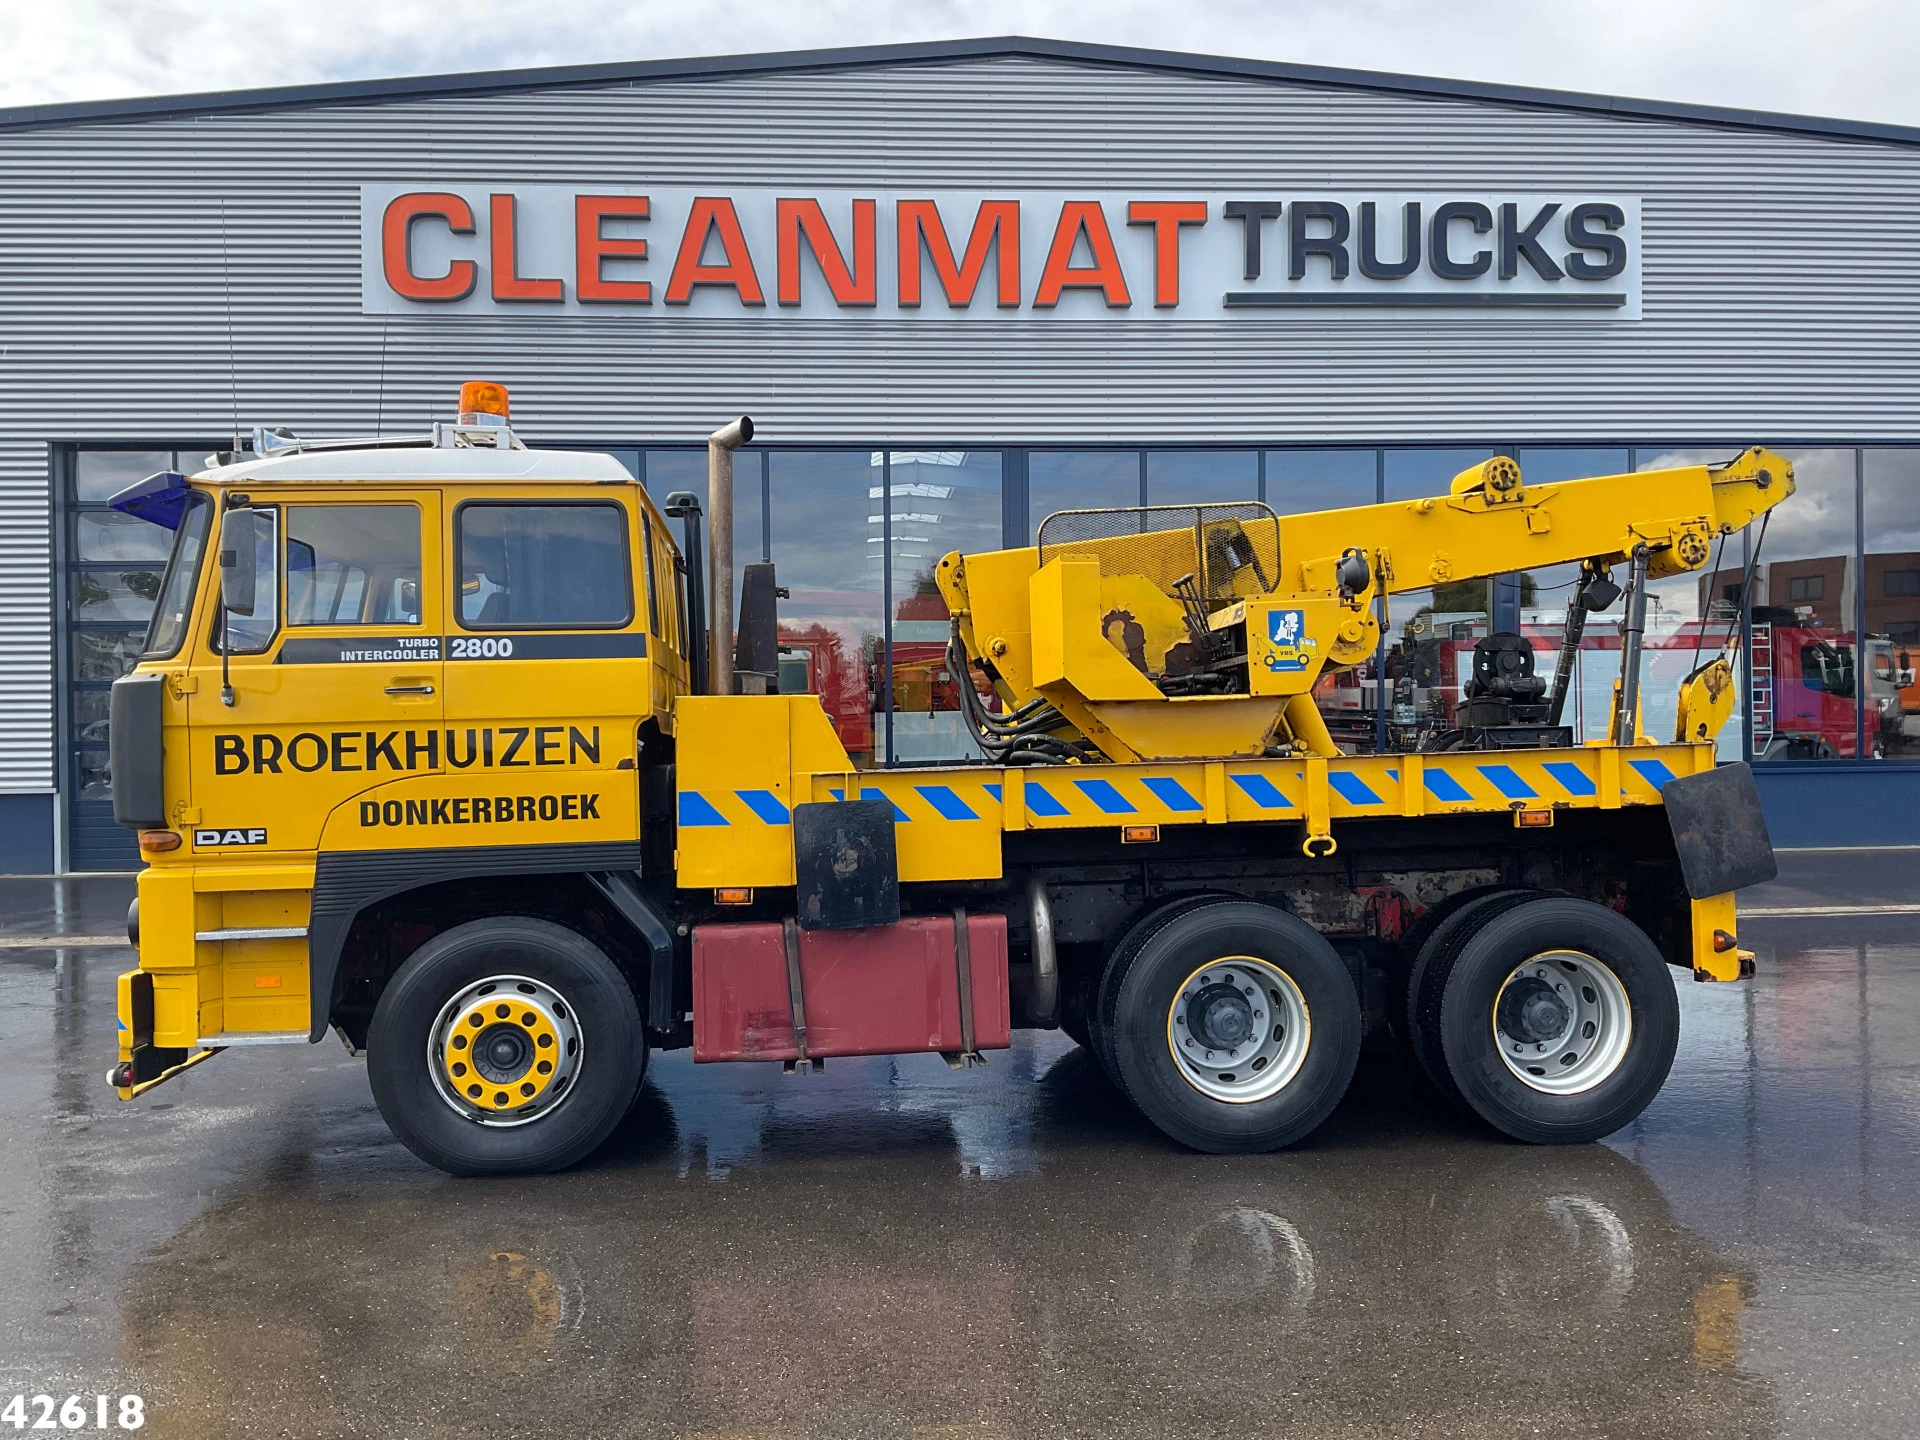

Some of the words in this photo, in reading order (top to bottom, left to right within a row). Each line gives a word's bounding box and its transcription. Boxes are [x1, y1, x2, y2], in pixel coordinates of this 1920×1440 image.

[382, 191, 1208, 309] CLEANMAT
[1222, 200, 1628, 282] TRUCKS
[397, 638, 439, 648] TURBO
[451, 638, 513, 658] 2800
[340, 649, 439, 662] INTERCOOLER
[214, 725, 600, 775] BROEKHUIZEN
[359, 793, 600, 827] DONKERBROEK
[196, 829, 265, 845] DAF
